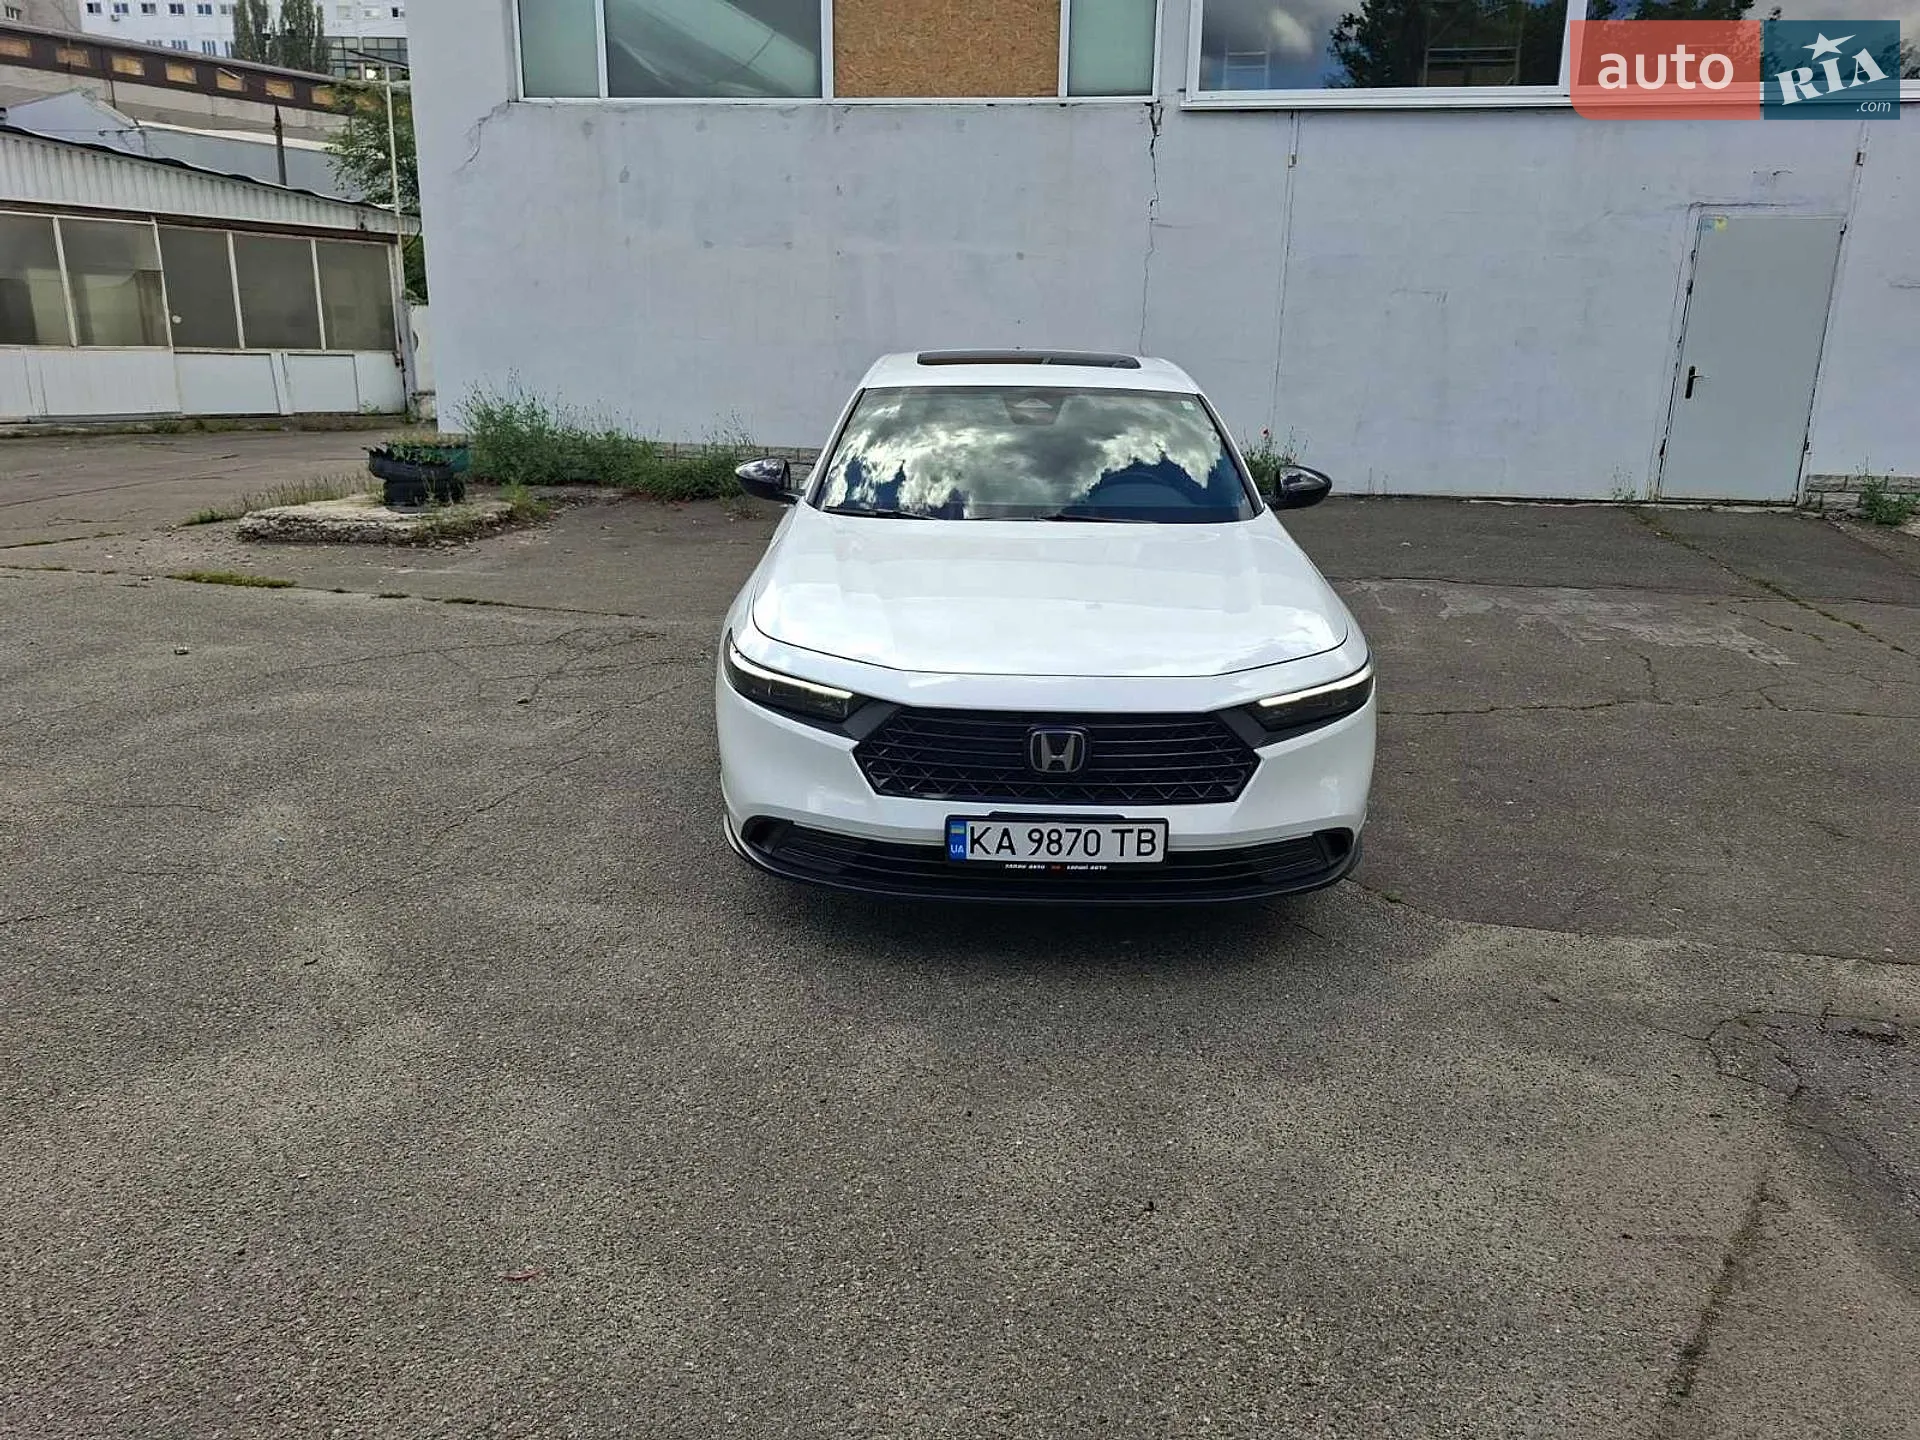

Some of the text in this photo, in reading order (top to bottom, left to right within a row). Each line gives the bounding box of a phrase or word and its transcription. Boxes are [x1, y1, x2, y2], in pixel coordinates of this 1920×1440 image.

[950, 844, 965, 854] UA
[970, 826, 1157, 857] KA 9870 TB
